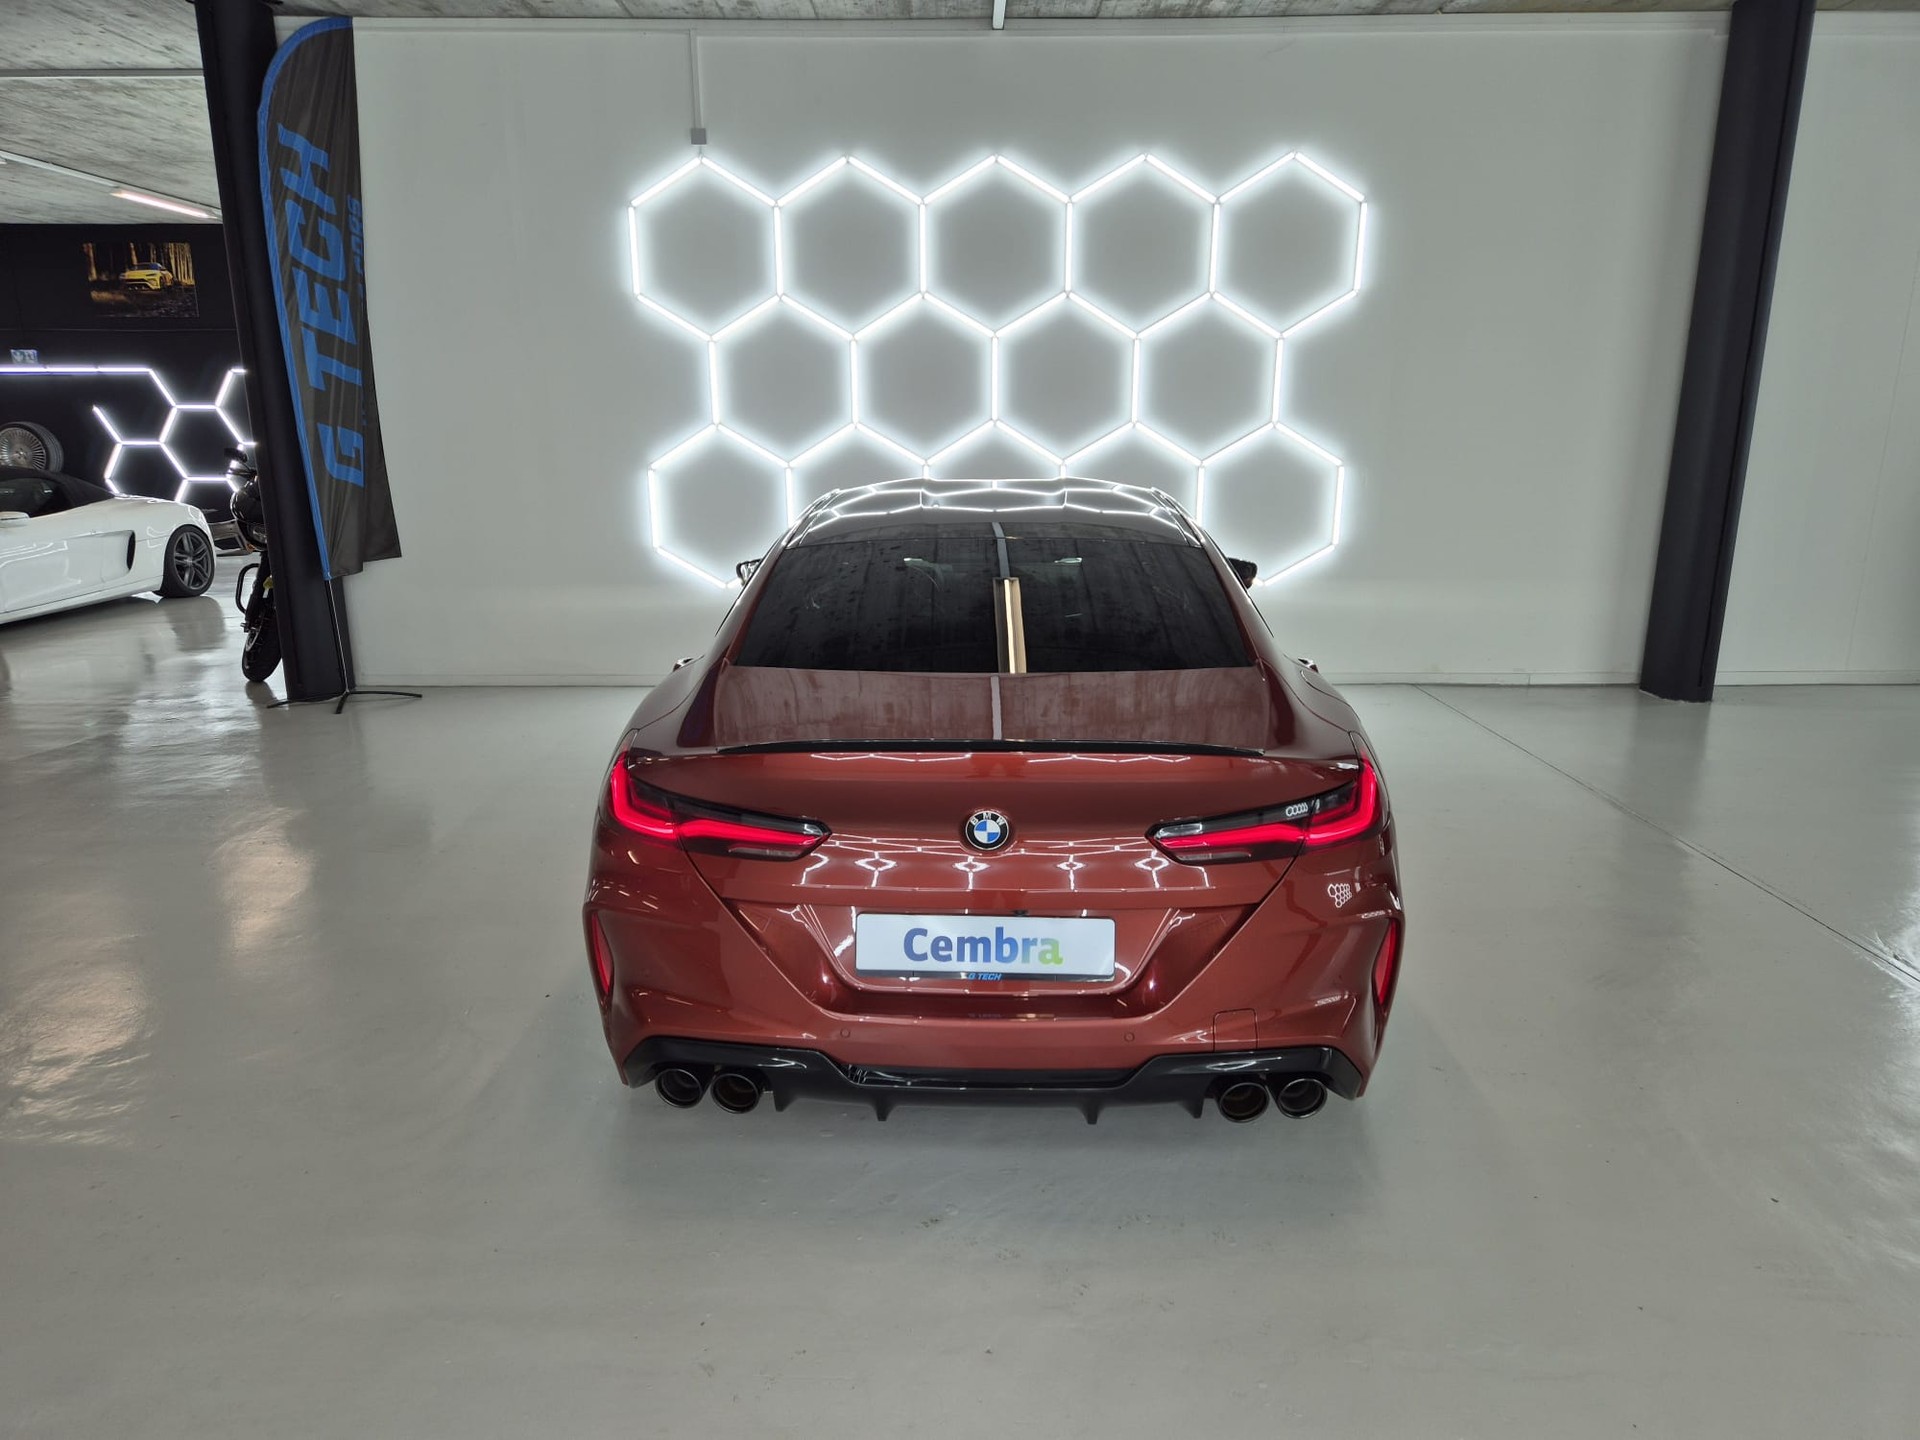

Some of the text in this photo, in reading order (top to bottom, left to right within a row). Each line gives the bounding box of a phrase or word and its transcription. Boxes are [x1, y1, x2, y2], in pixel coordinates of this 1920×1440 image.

[277, 122, 364, 488] G TECH
[969, 811, 1006, 826] BMW
[903, 926, 1064, 966] Cembra
[978, 972, 1003, 982] TECH
